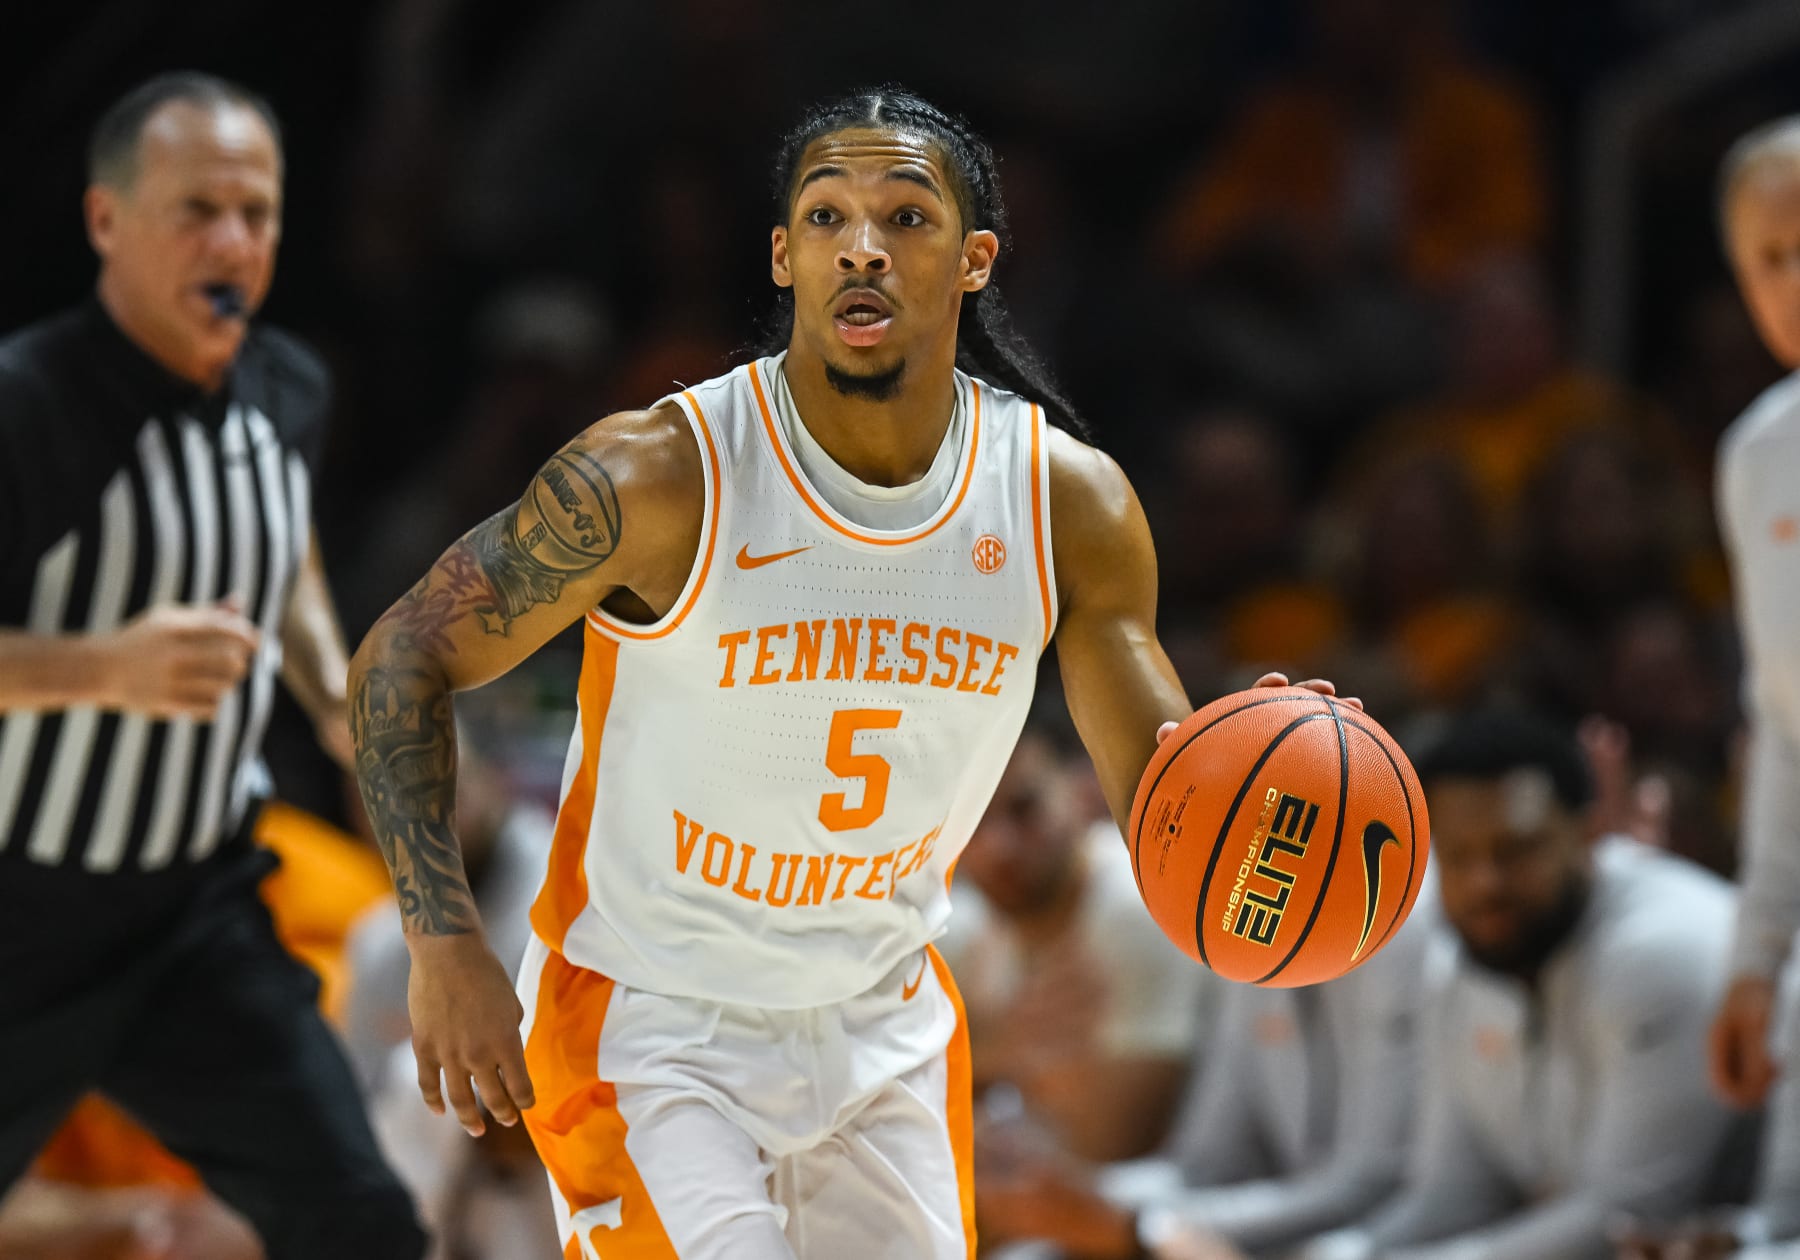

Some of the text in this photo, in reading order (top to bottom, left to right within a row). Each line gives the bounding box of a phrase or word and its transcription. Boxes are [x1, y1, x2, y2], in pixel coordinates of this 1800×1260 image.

[974, 538, 1006, 574] SEC
[717, 617, 1020, 696] TENNESSEE
[817, 708, 904, 832] 5
[1221, 787, 1277, 932] CHAMPIONSHIP
[1232, 792, 1321, 948] ELITE
